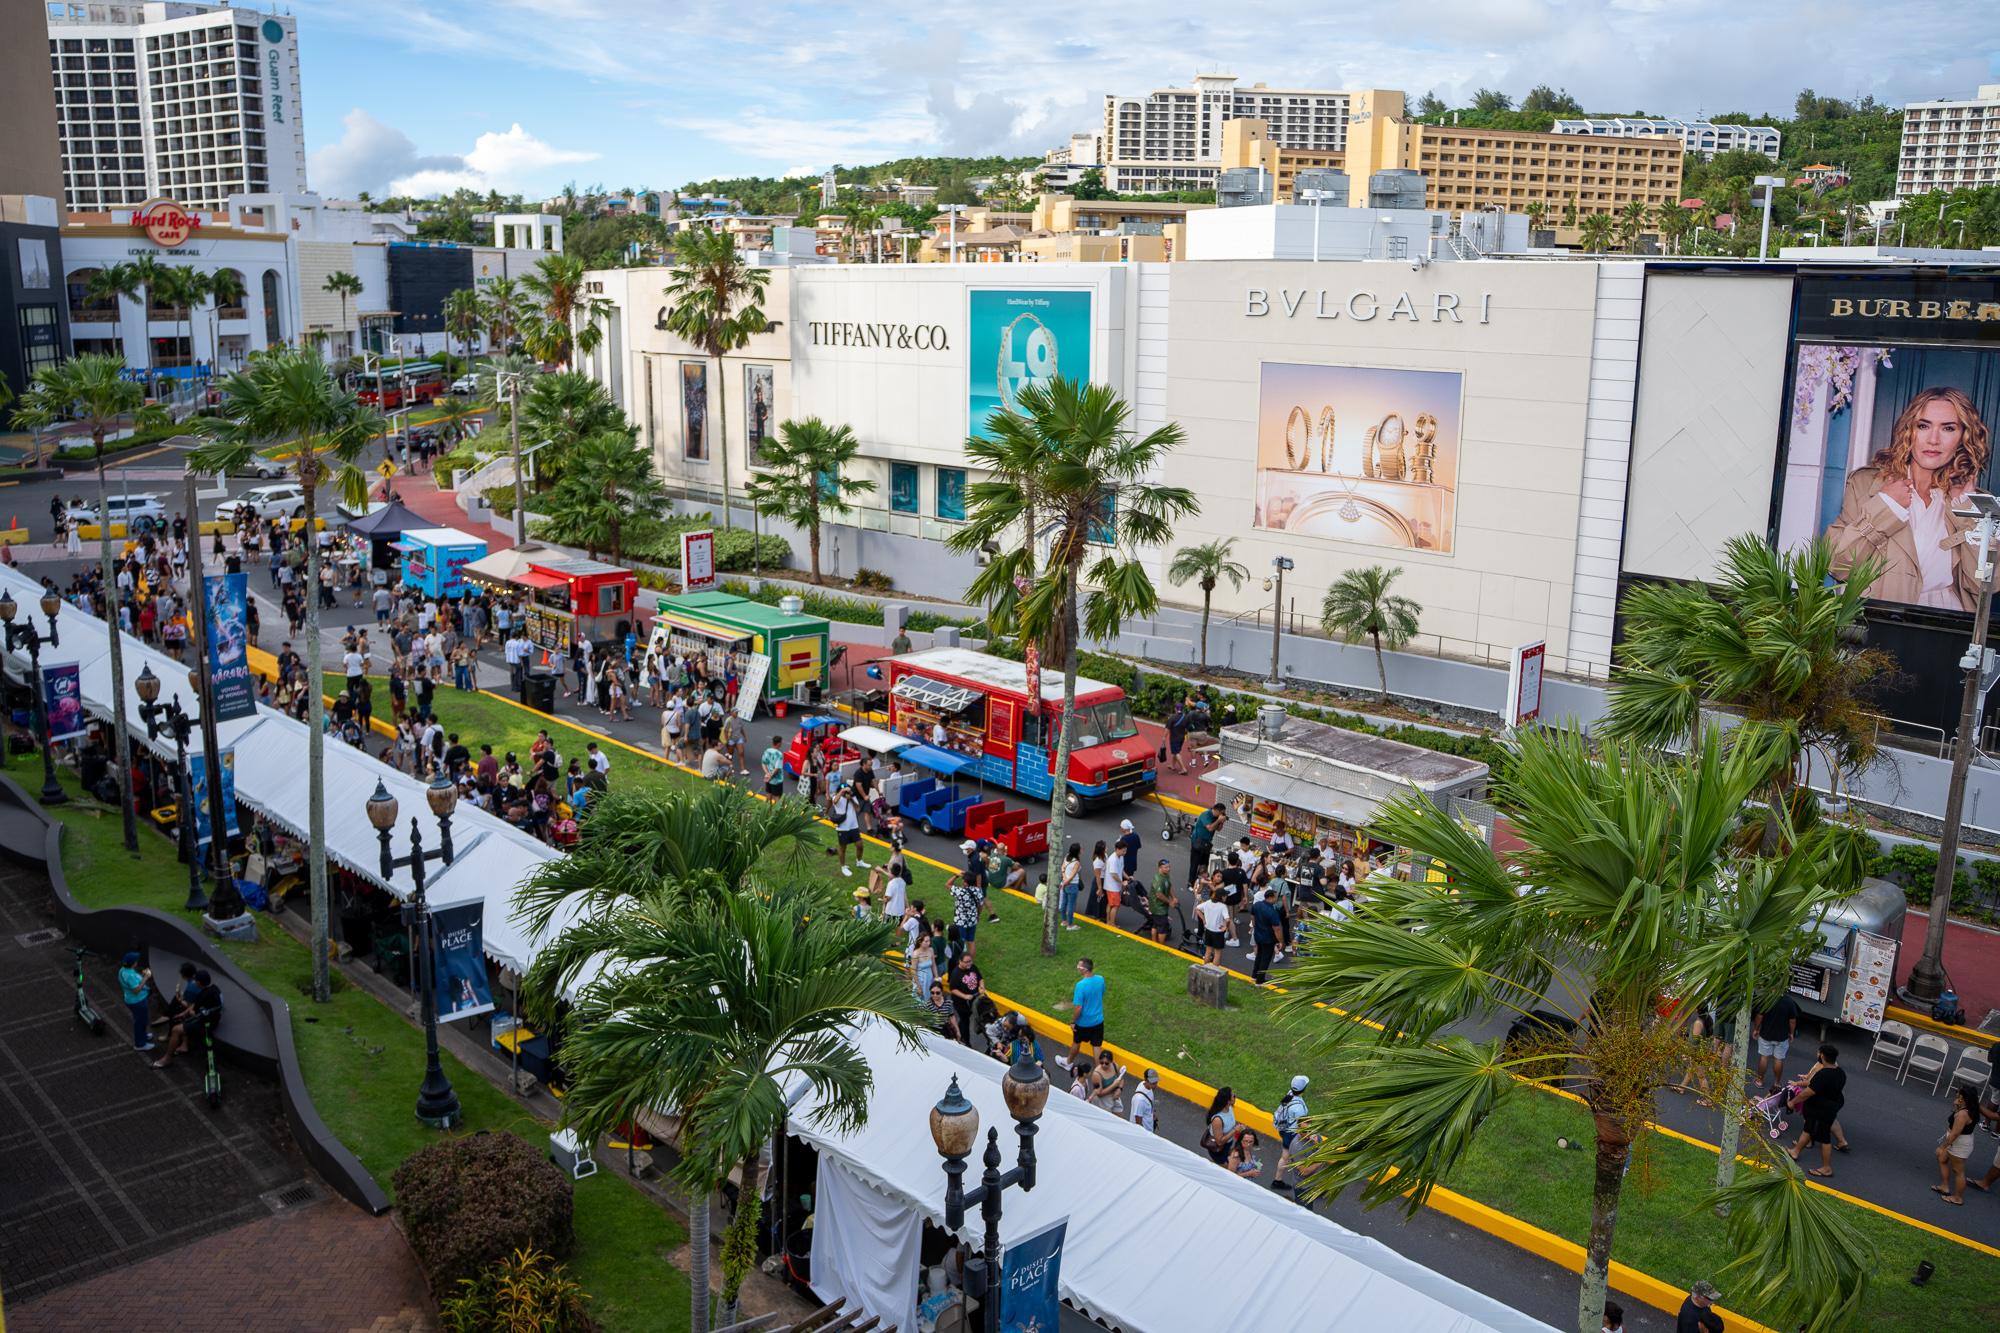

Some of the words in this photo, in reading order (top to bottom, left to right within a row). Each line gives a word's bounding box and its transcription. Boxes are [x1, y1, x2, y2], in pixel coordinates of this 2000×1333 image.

[268, 49, 280, 91] Guam
[271, 94, 285, 125] Reef
[131, 210, 167, 228] Hard
[168, 211, 202, 230] Rock
[127, 248, 147, 256] LOVE
[147, 248, 160, 256] ALL
[187, 248, 201, 256] ALL
[1245, 288, 1492, 324] BVLGARI
[808, 321, 950, 351] TIFFANY&CO.
[441, 931, 473, 949] PLACE
[1011, 1260, 1049, 1290] PLACE
[1021, 1257, 1044, 1275] DUSIT
